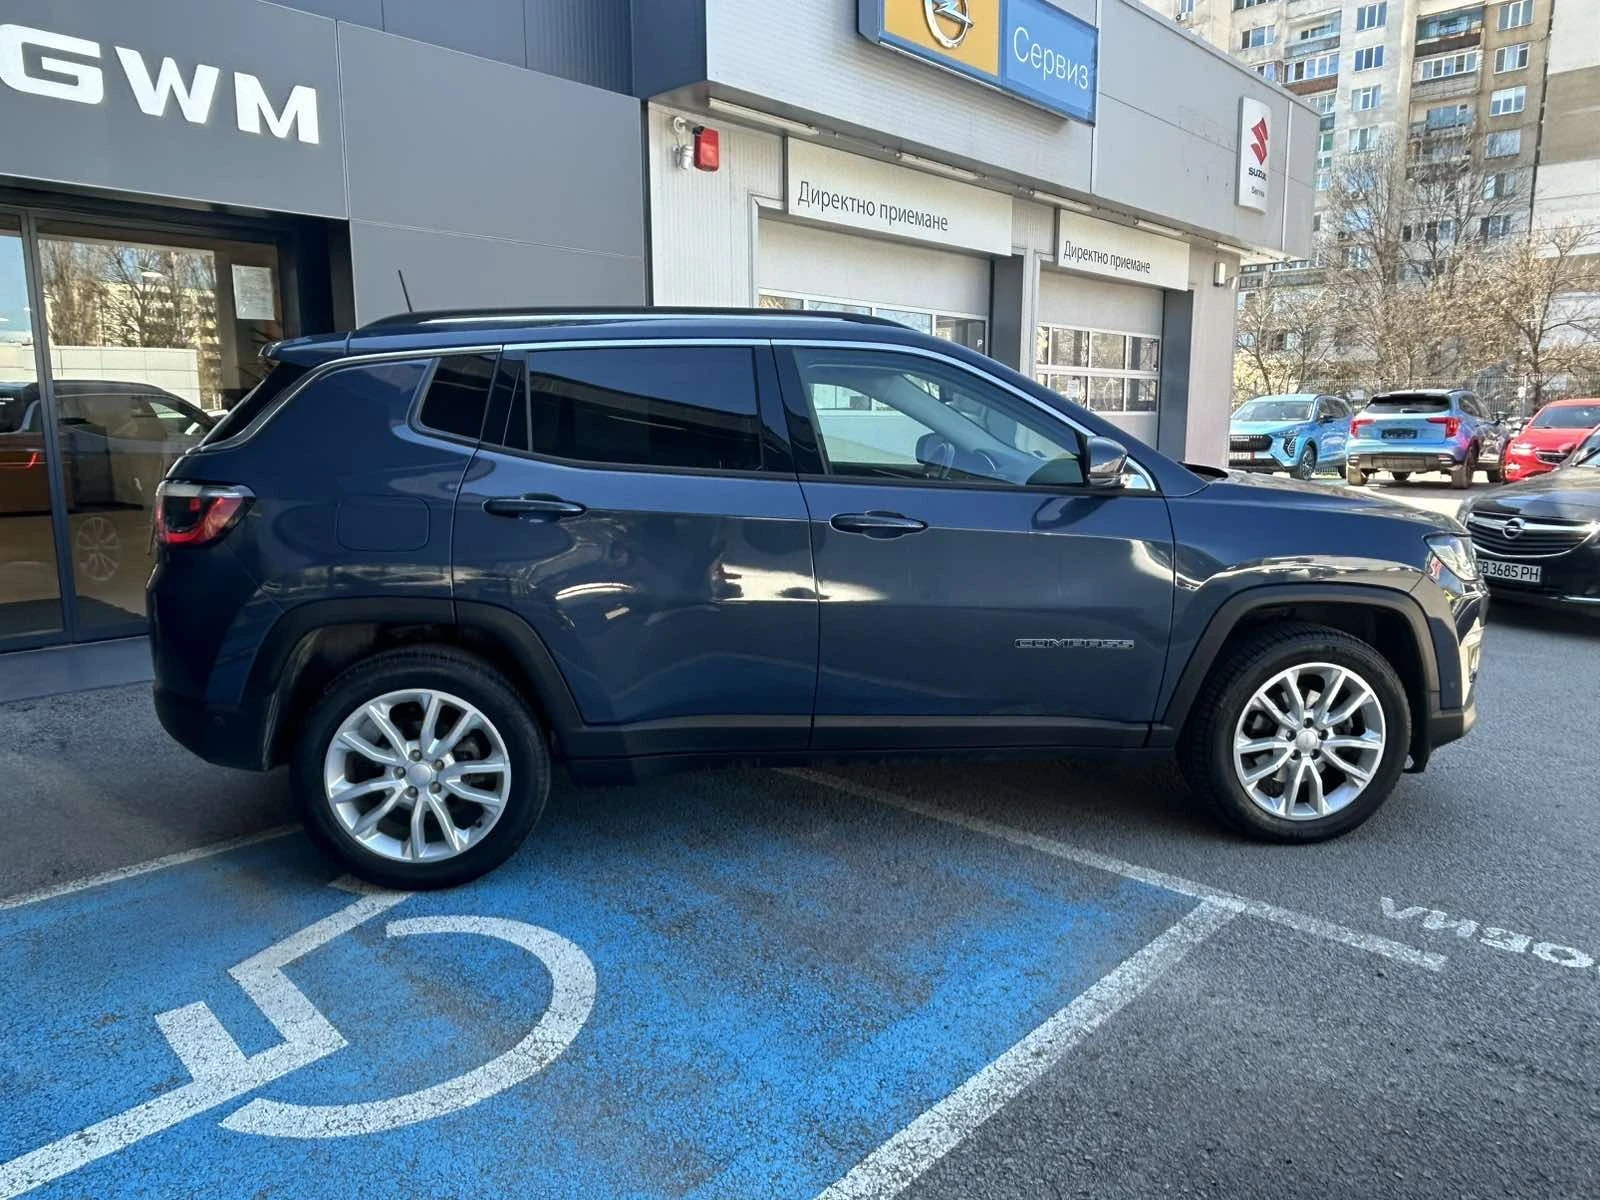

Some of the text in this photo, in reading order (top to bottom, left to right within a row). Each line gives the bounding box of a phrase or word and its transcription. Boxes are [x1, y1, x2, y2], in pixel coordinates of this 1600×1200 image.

[1013, 26, 1088, 90] Сервиз
[0, 23, 319, 144] GWM
[798, 180, 948, 231] Директно приемане
[1063, 240, 1151, 273] Директно приемане
[1490, 562, 1518, 578] 3685
[1520, 566, 1540, 581] PH
[1014, 638, 1135, 649] COMPASS
